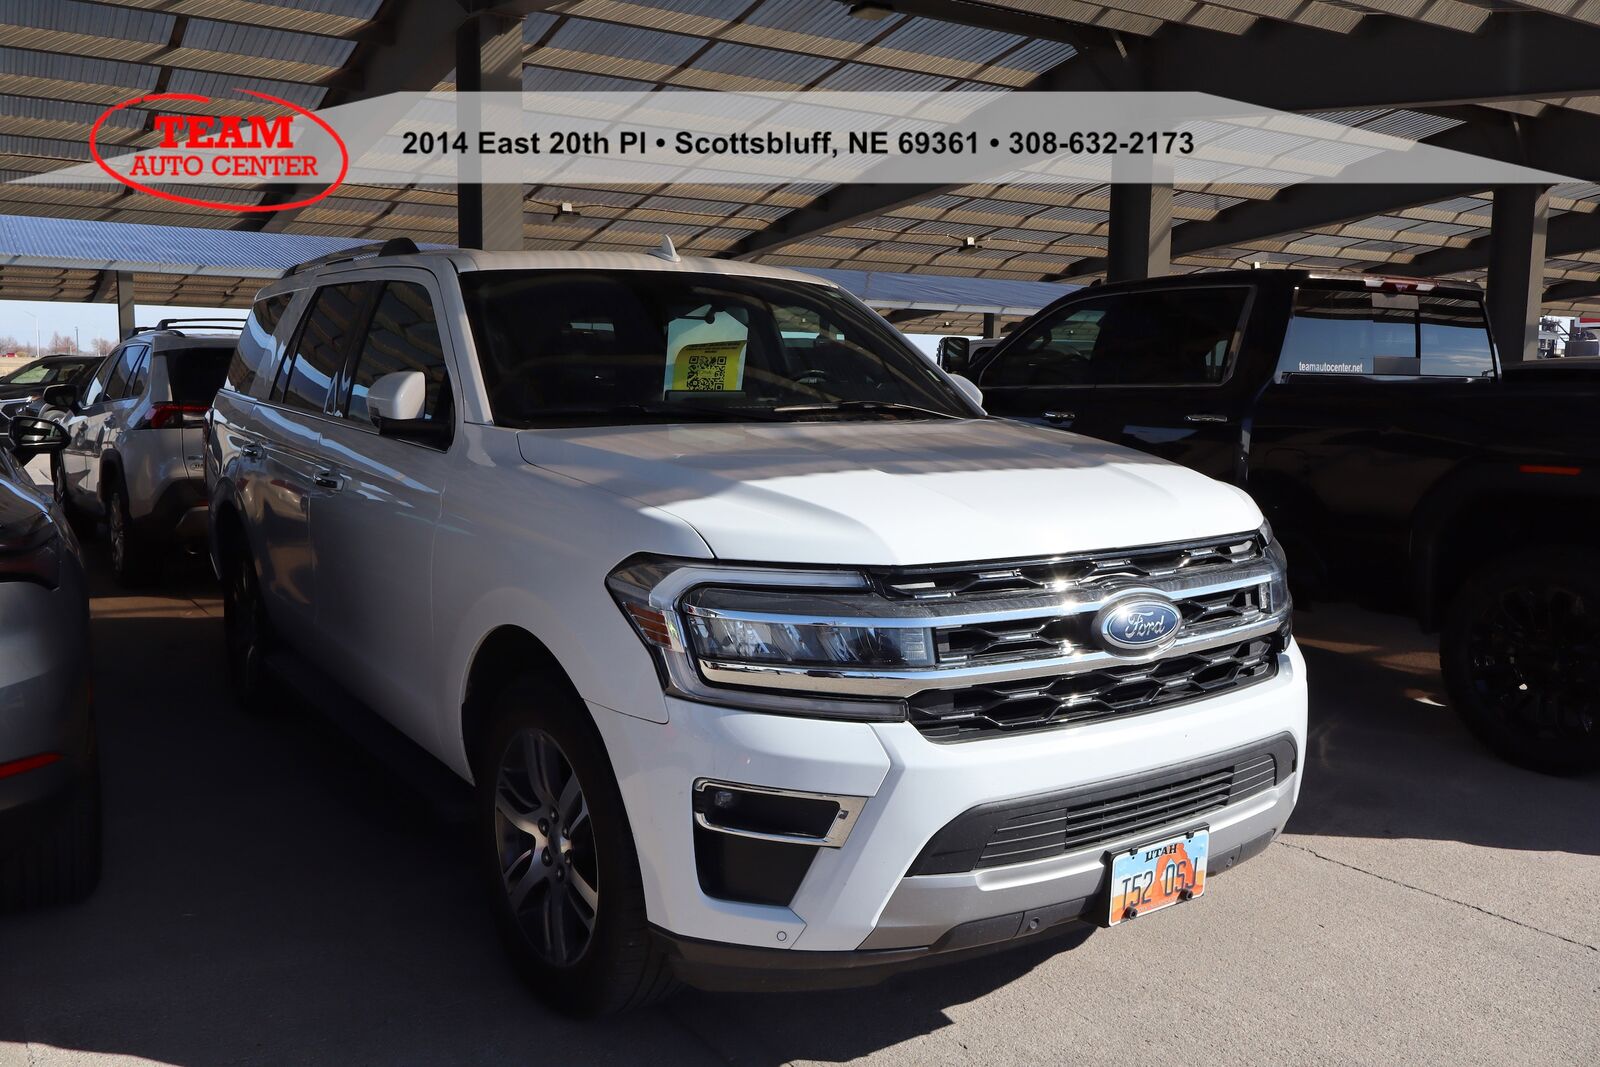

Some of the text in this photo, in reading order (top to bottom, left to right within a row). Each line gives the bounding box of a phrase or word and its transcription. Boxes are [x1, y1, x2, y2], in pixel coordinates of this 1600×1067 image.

[1298, 361, 1363, 373] teamautocenter.net
[1124, 611, 1165, 639] Ford
[1145, 843, 1178, 863] UTAH
